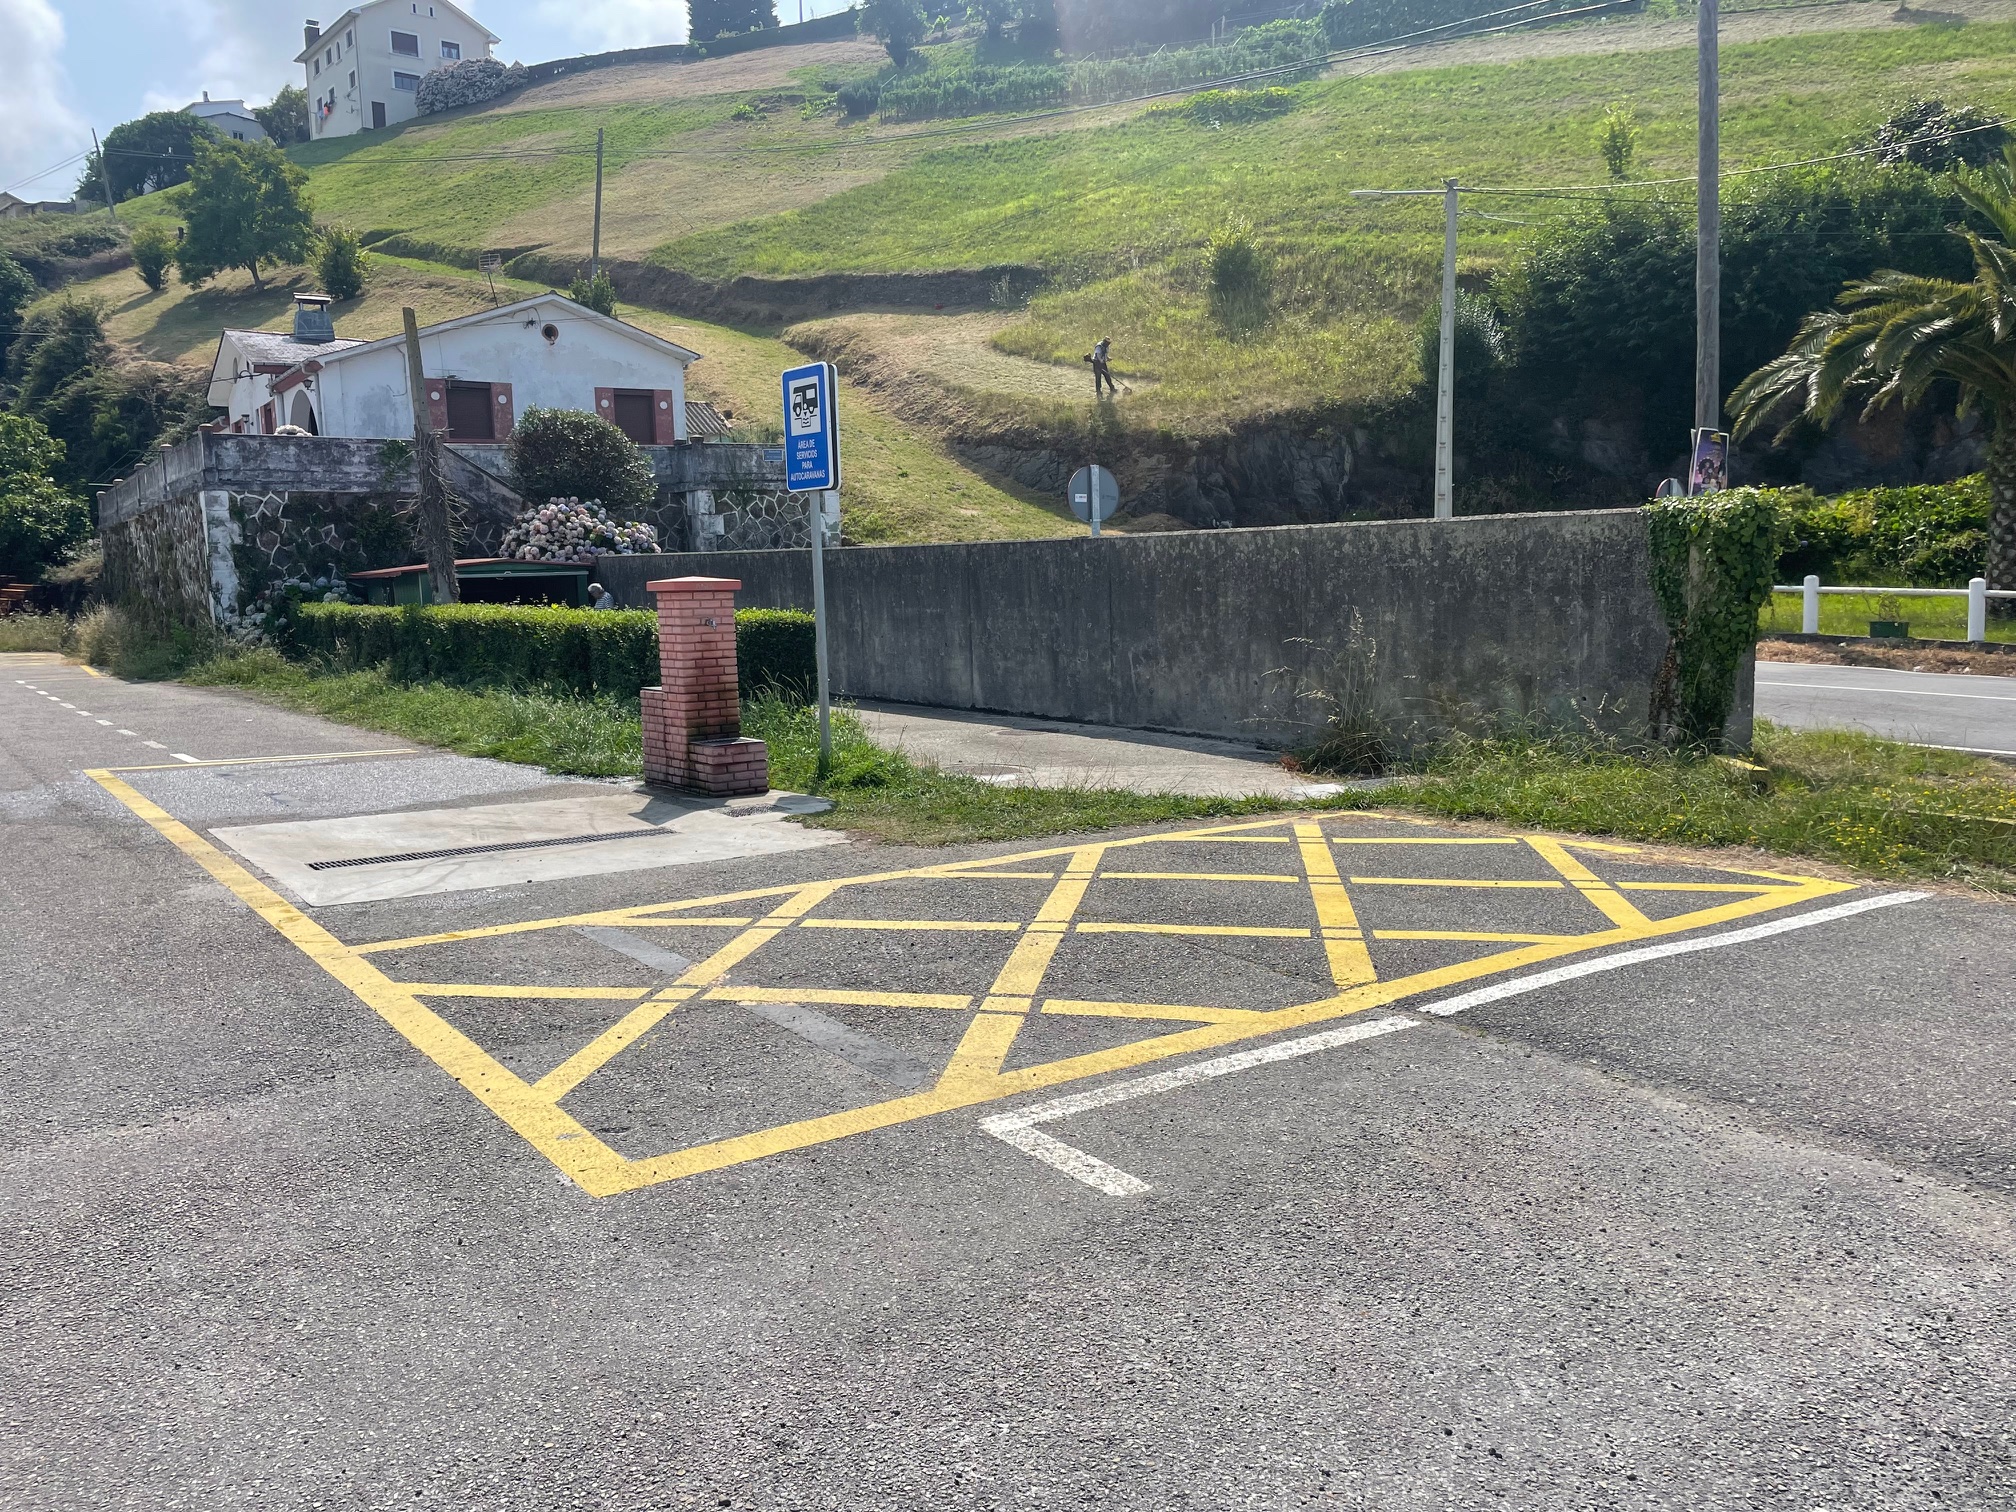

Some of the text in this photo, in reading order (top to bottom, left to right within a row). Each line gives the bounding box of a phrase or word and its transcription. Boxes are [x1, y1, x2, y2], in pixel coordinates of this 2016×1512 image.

[798, 439, 809, 450] ÁREA
[796, 449, 818, 460] SERVICIOS
[801, 460, 814, 470] PARA
[790, 469, 826, 482] AUTOCARAVANAS
